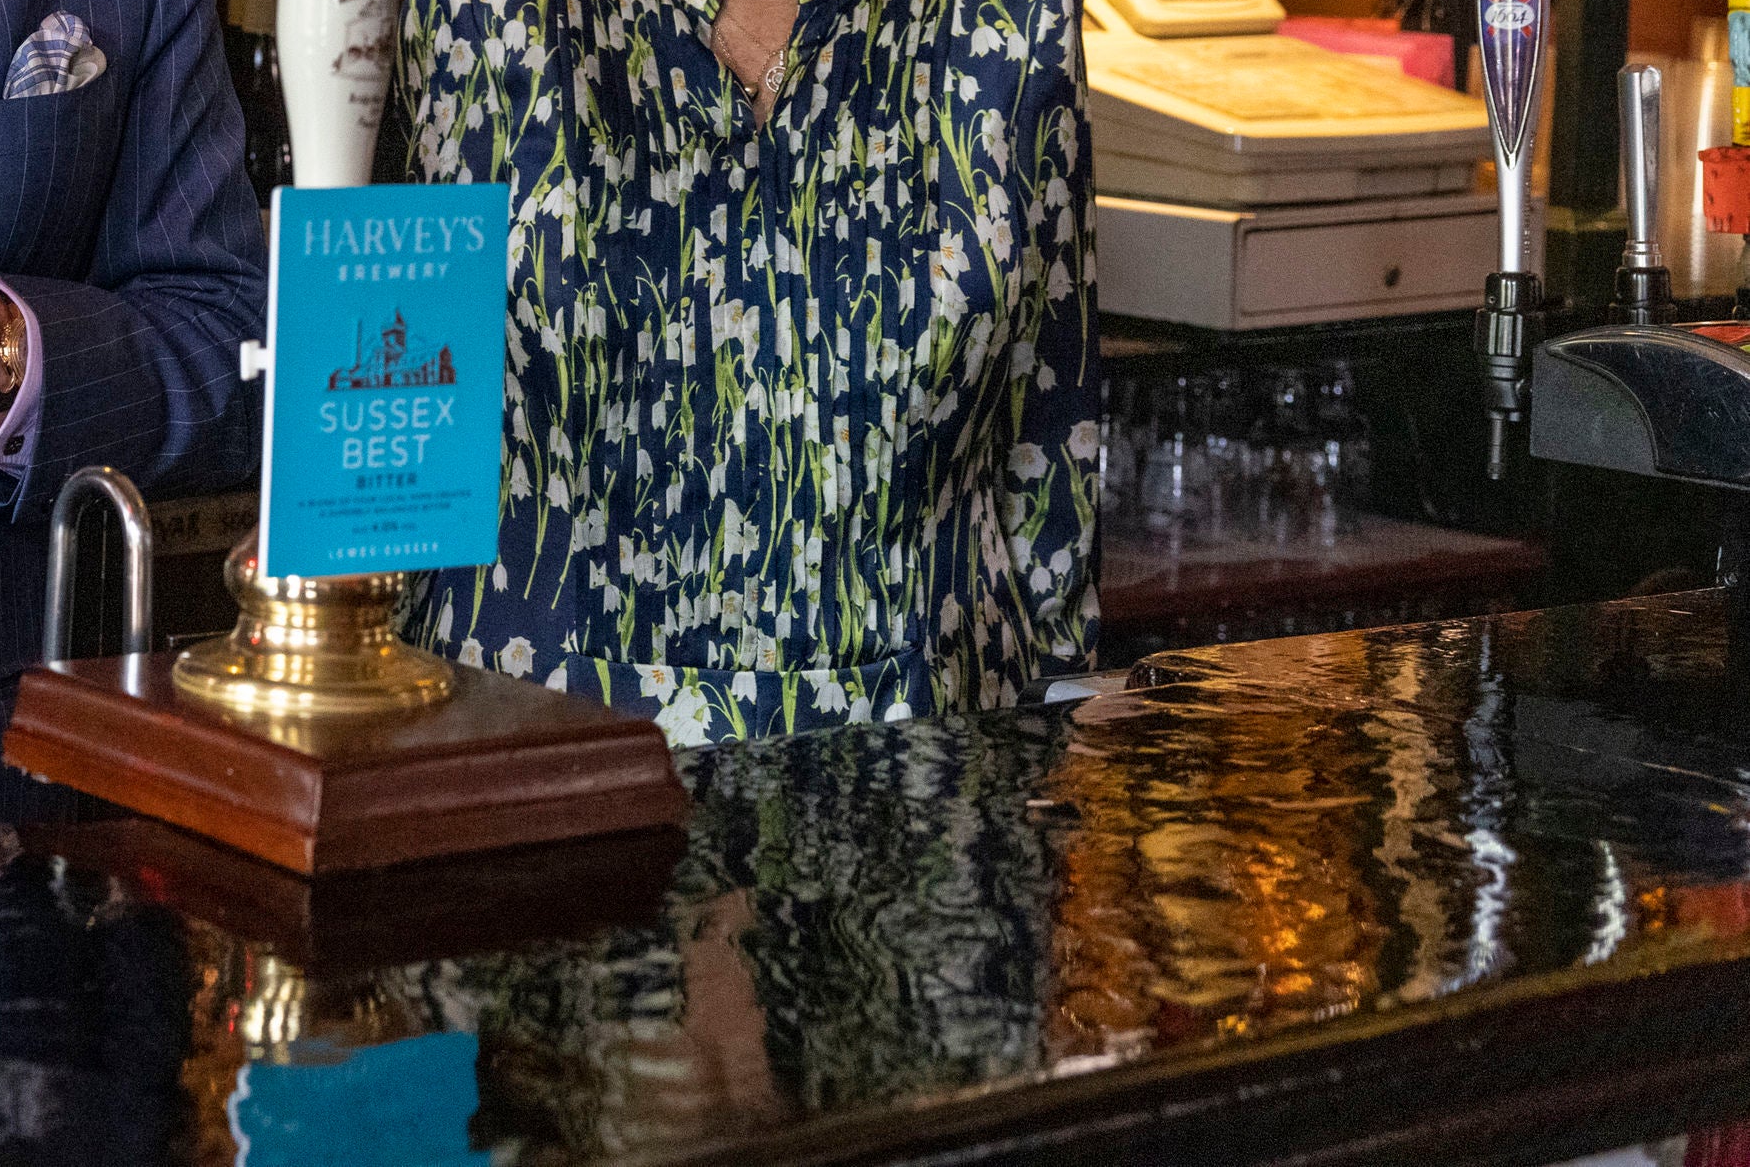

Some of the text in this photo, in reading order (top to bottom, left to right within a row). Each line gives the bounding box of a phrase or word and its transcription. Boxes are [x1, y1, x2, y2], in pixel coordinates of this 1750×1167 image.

[1490, 9, 1529, 25] 1664
[305, 214, 485, 256] HARVEY'S
[319, 397, 455, 434] SUSSEX
[341, 433, 432, 470] BEST
